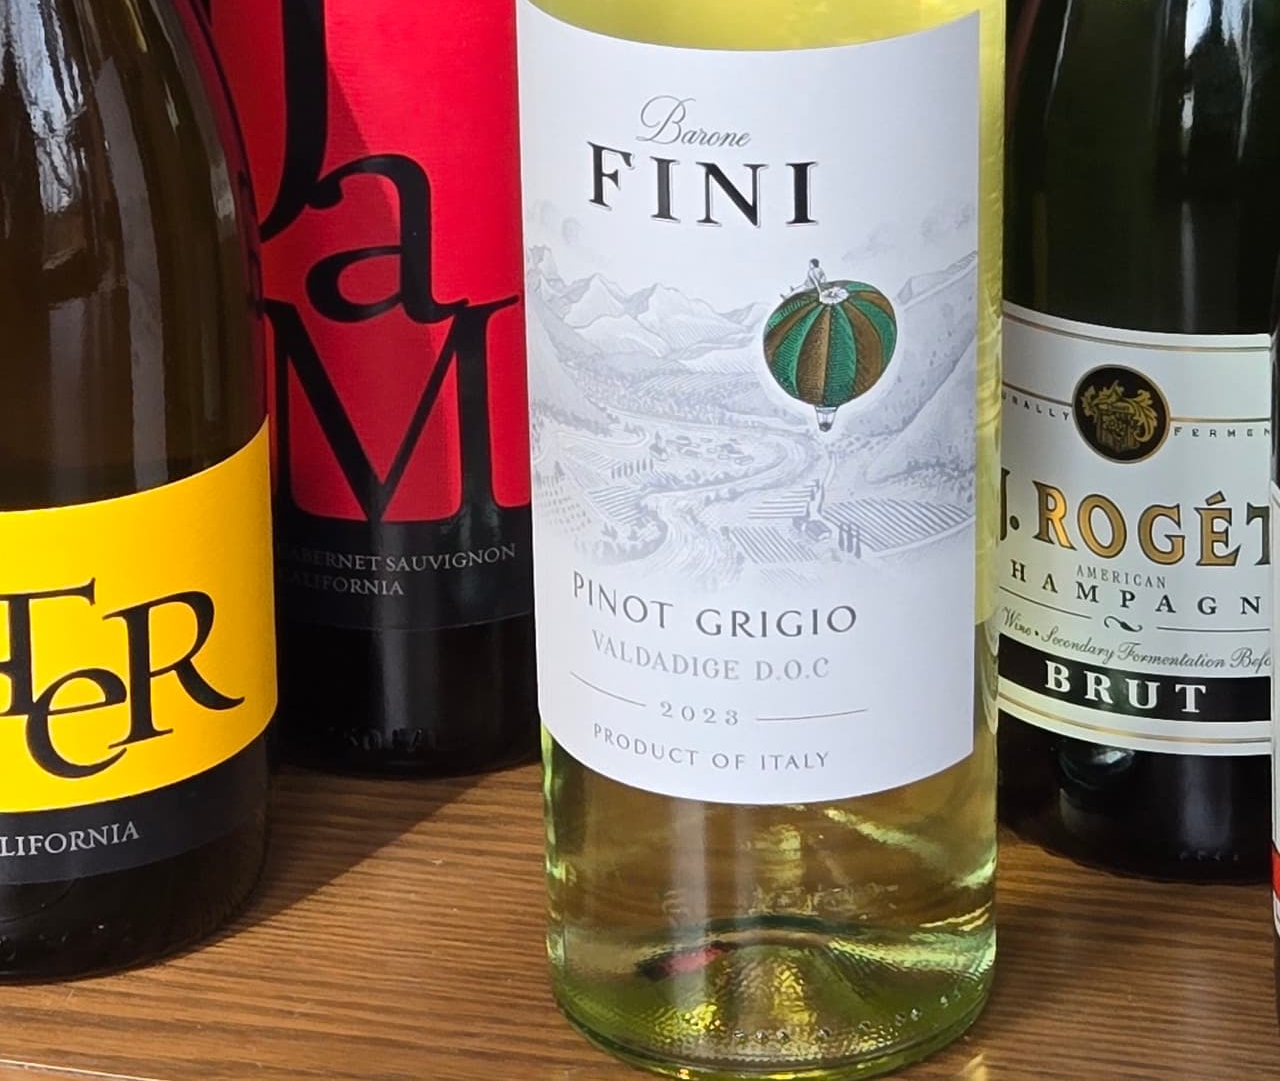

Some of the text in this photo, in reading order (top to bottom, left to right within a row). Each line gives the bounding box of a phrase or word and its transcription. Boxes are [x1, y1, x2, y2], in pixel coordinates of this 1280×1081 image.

[635, 94, 751, 149] Barone
[586, 138, 820, 229] FINI
[286, 542, 516, 573] ABERNET SAUVIGNON
[1076, 564, 1167, 589] AMERICAN
[282, 568, 404, 597] ALIFORNIA
[573, 569, 857, 639] PINOT GRIGIO
[592, 629, 830, 682] VALDADIGE D.O.C
[1041, 625, 1114, 665] Secondary
[1117, 640, 1225, 667] Fermentation
[1043, 658, 1207, 715] BRUT
[659, 700, 739, 727] 2023
[593, 722, 830, 771] PRODUCT OF ITALY
